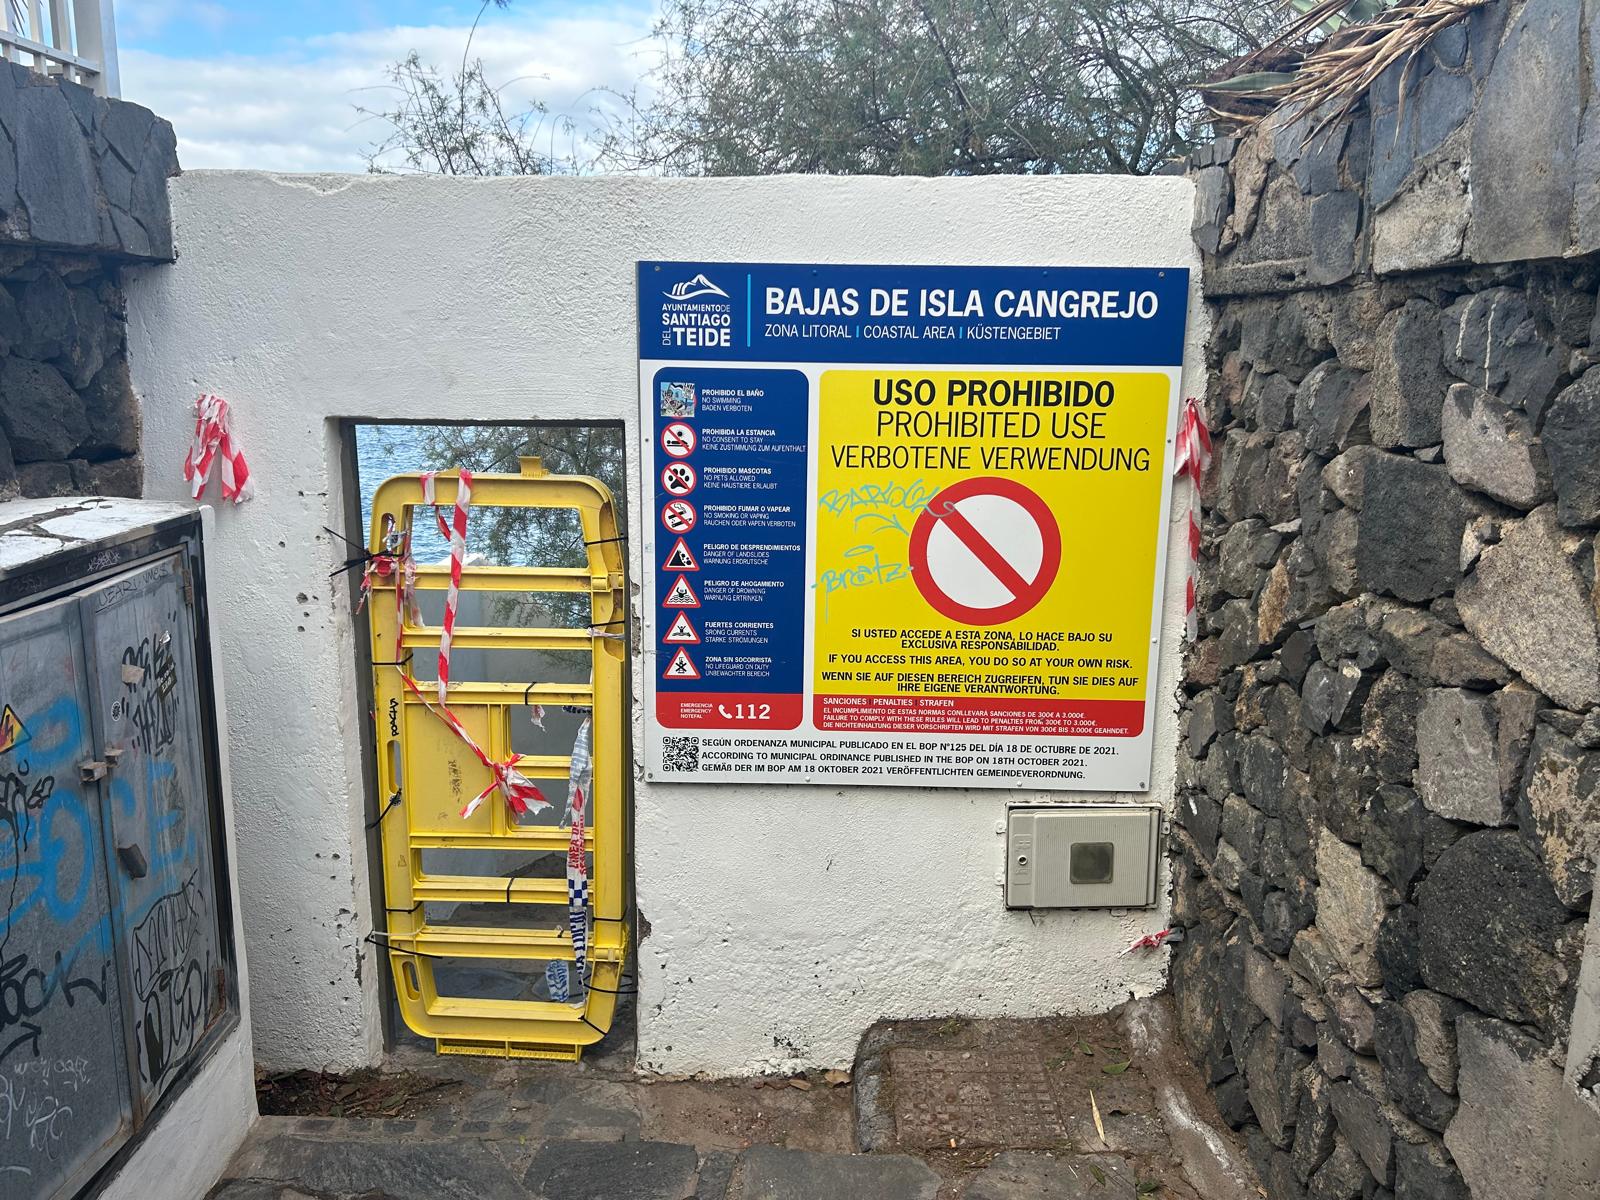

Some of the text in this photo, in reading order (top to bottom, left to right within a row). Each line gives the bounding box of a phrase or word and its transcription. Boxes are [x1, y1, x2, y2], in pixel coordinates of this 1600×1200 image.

[766, 288, 1157, 318] BAJAS DE ISLA CANGREJO
[662, 313, 730, 326] SANTIAGO
[662, 328, 730, 347] DEL TEIDE
[764, 324, 1060, 340] ZONA LITORAL COASTAL AREA KÜSTENGEBIET
[874, 379, 1114, 406] USO PROHIBIDO
[877, 411, 1105, 439] PROHIBITED USE
[831, 446, 1149, 471] VERBOTENE VERWENDUNG
[851, 628, 1112, 642] SI USTED ACCEDE A ESTA ZONA, LO HACE BAJO SU
[901, 639, 1059, 651] EXCLUSIVA RESPONSABILIDAD.
[828, 654, 1132, 668] IF YOU ACCESS THIS AREA, YOU DO SO AT YOUR OWN RISK.
[821, 672, 1138, 686] WENN SIE AUF DIESEN BEREICH ZUGREIFEN, TUN SIE DIES AUF
[897, 683, 1060, 694] IHRE EIGENE VERANTWORTUNG.
[735, 704, 769, 719] 112
[702, 738, 731, 746] SEGÚN
[1020, 745, 1031, 753] DE
[1034, 745, 1075, 754] OCTUBRE
[1078, 746, 1090, 754] DE
[1093, 746, 1119, 755] 2021.
[1017, 758, 1059, 766] OCTOBER
[1062, 758, 1088, 766] 2021.
[886, 767, 973, 776] VERÖFFENTLICHTEN
[976, 769, 1085, 778] GEMEINDEVERORDNUNG.
